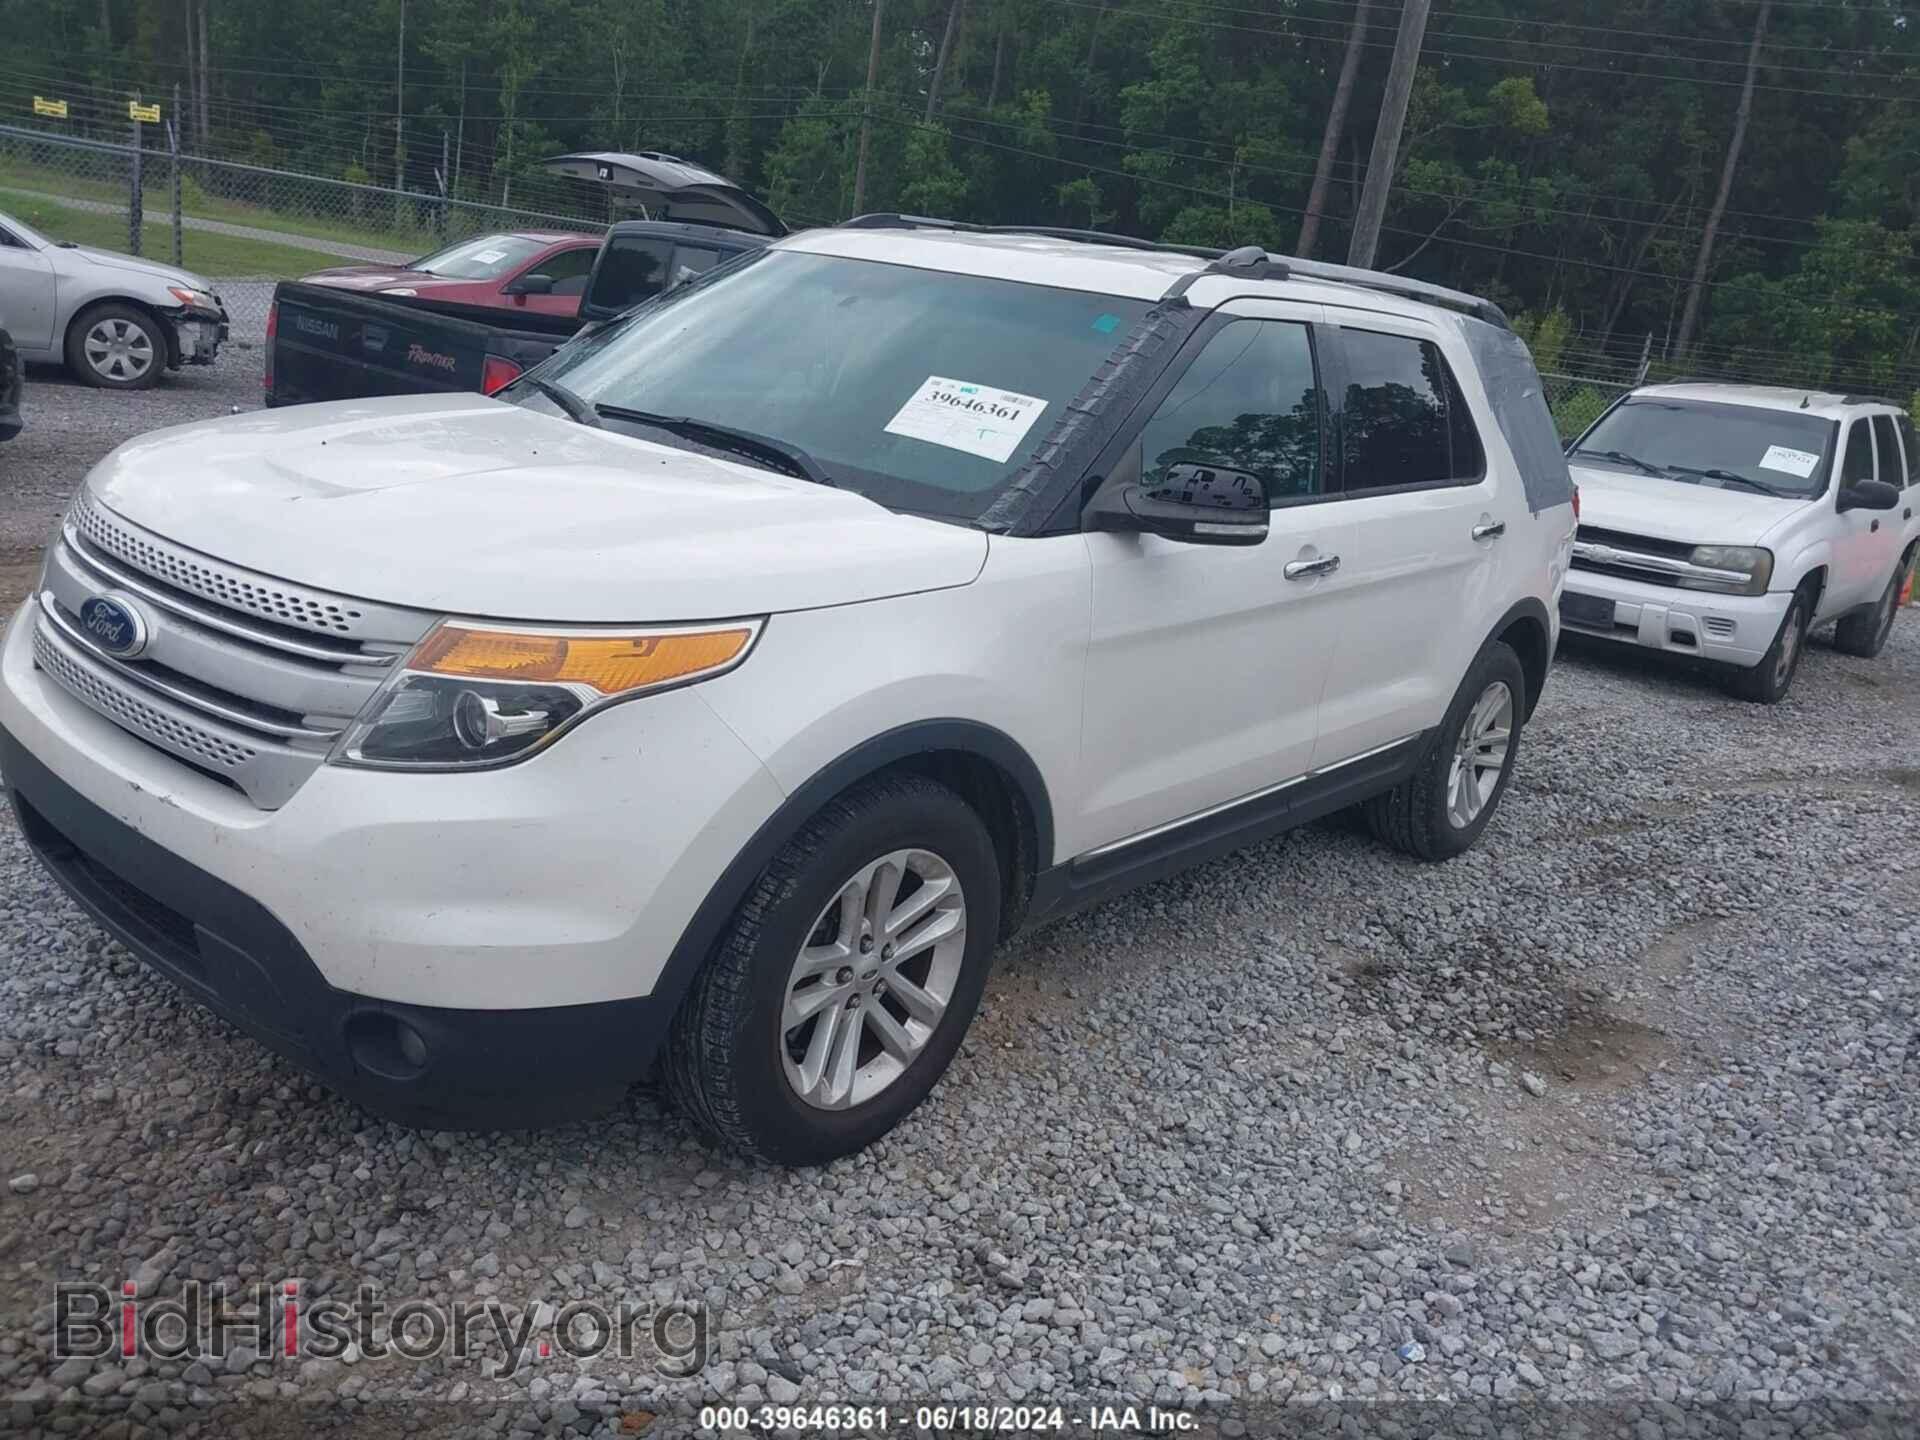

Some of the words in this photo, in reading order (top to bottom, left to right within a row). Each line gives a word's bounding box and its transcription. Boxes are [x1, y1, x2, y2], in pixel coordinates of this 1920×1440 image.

[297, 313, 339, 340] NISSAN
[925, 391, 1020, 421] 39646361
[87, 602, 125, 642] Ford
